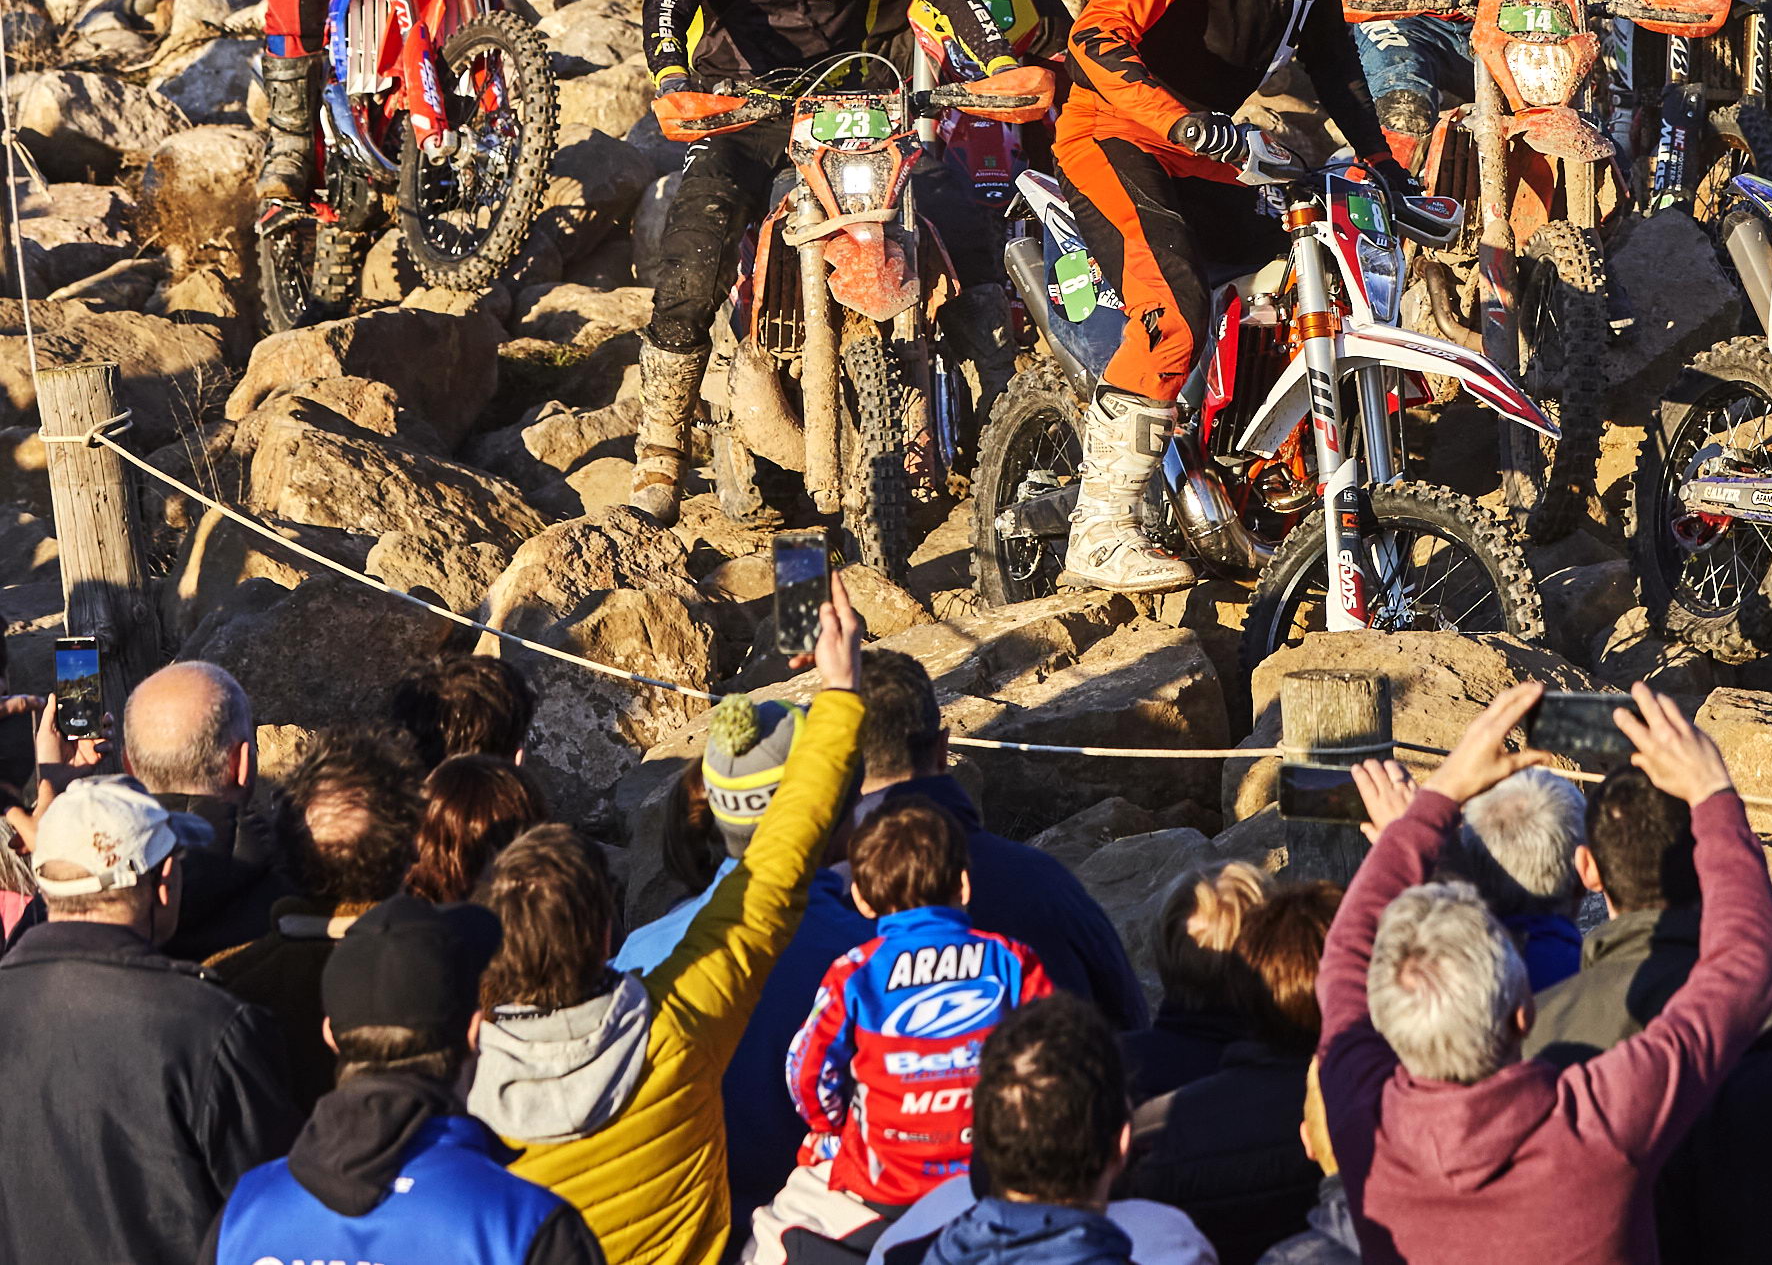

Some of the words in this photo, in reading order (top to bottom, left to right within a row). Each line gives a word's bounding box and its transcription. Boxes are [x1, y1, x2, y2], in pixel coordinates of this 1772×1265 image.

[1522, 9, 1553, 33] 14
[835, 112, 871, 138] 23
[1654, 118, 1673, 191] Mitas
[1371, 201, 1385, 233] 8
[1060, 273, 1090, 295] 8
[1112, 401, 1128, 416] 12
[1307, 366, 1339, 453] WP
[886, 942, 985, 993] ARAN
[901, 1088, 974, 1115] MOT
